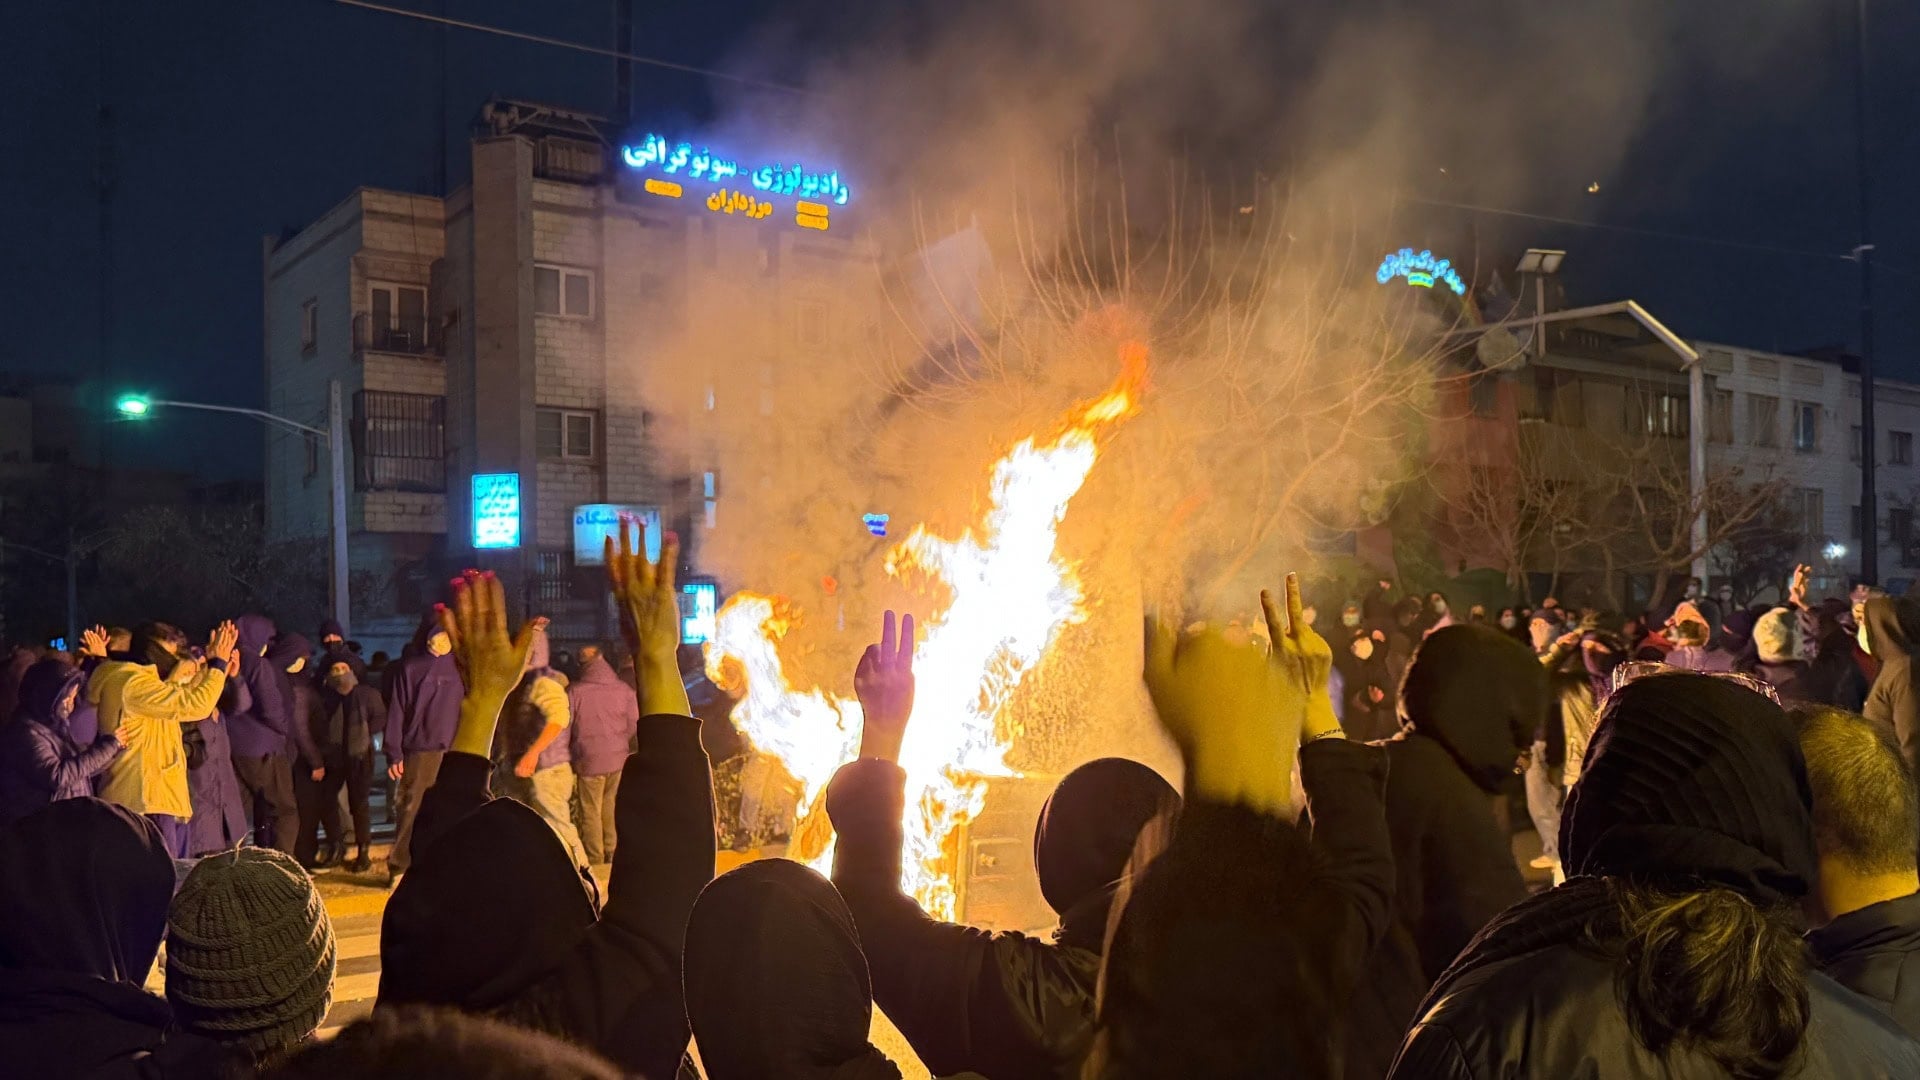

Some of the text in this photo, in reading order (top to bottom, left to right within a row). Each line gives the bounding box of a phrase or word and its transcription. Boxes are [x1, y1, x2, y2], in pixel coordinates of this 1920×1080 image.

[622, 133, 737, 182] سونوگرافی
[706, 188, 773, 220] مرزداران
[752, 162, 850, 205] رادیولوژی
